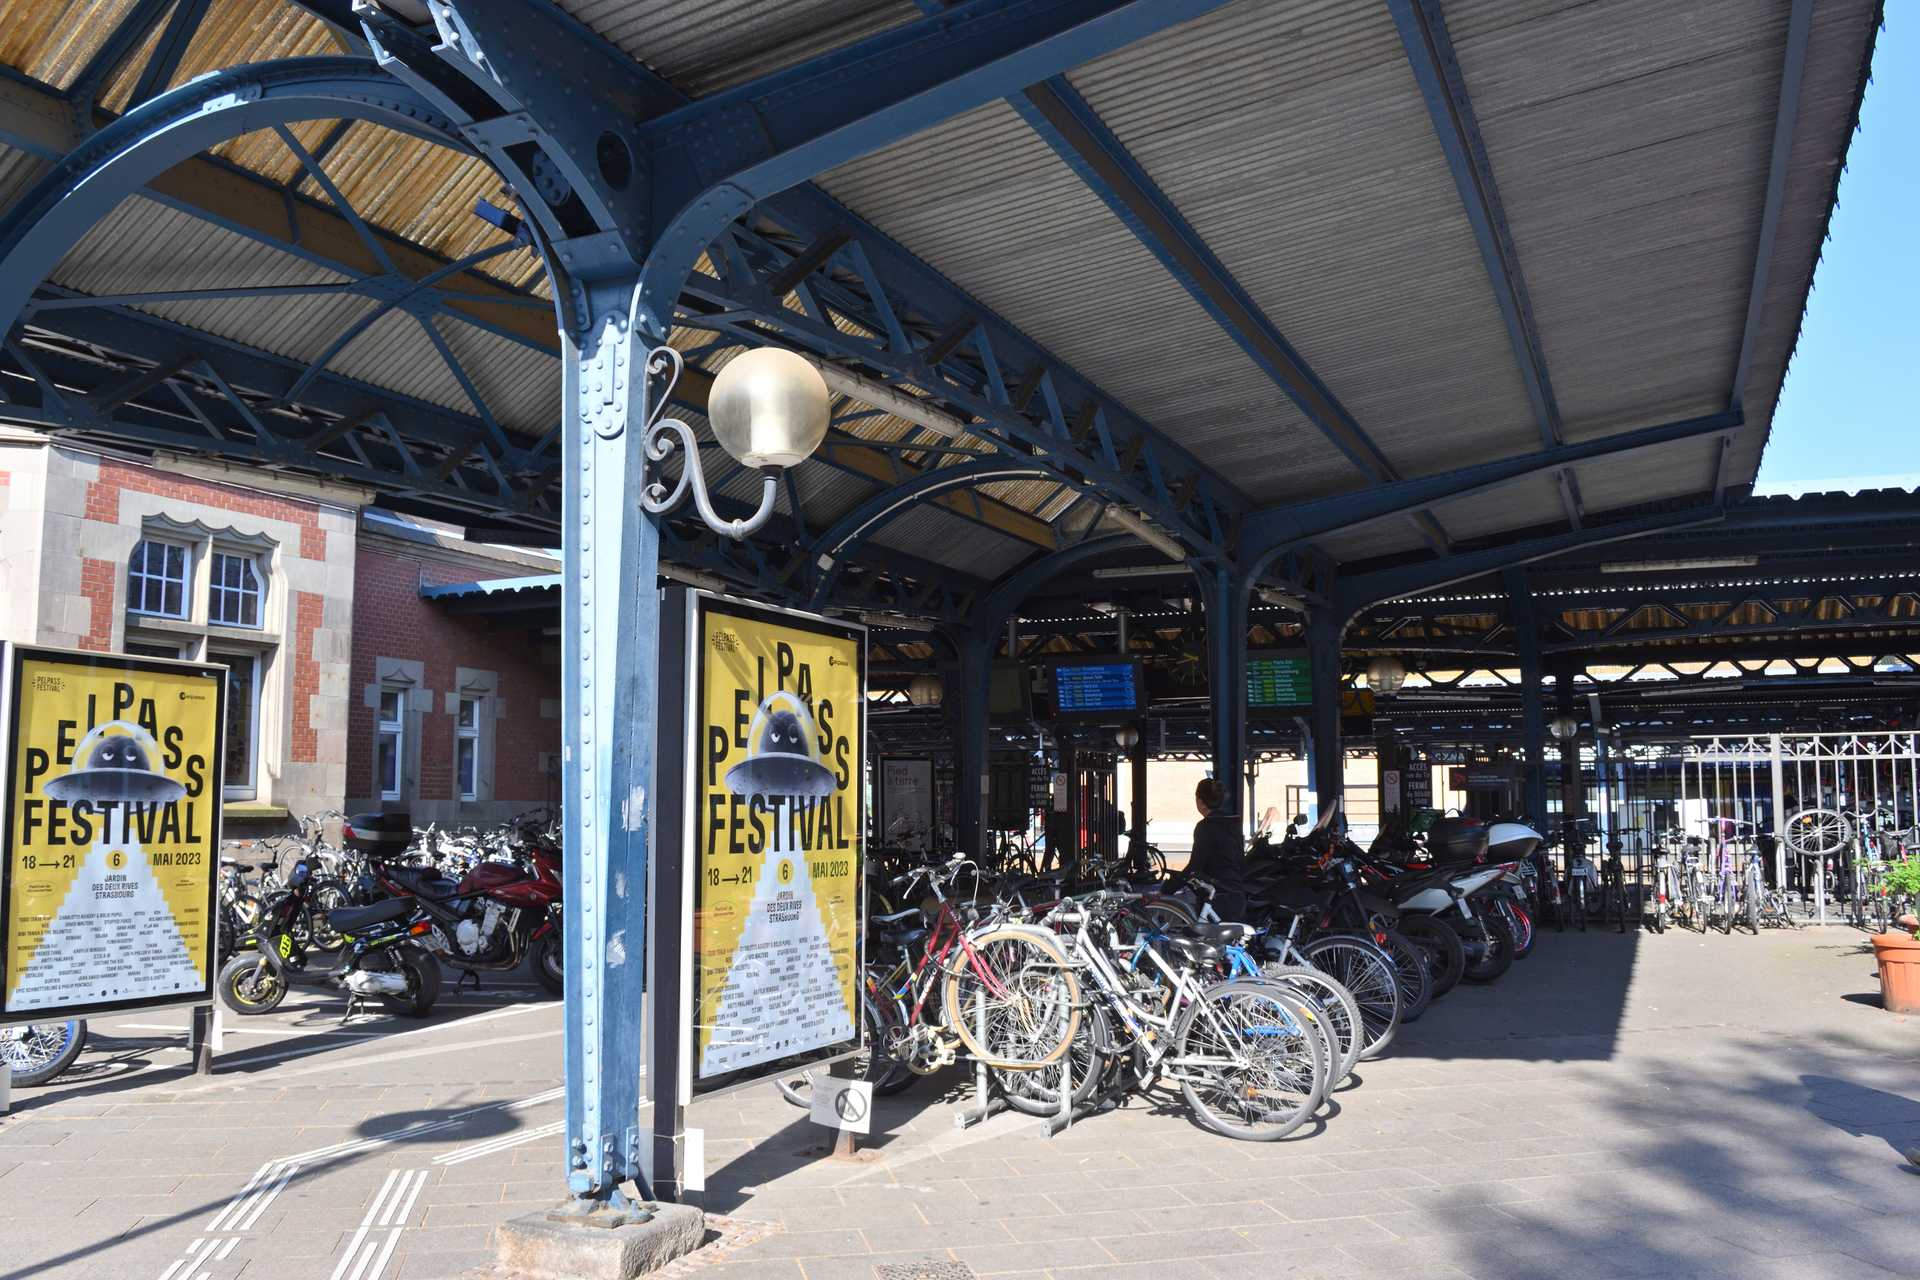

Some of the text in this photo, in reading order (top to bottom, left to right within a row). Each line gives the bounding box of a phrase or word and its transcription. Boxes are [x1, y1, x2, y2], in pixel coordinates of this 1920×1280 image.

[23, 800, 201, 845] FESTIVAL
[707, 793, 849, 855] FESTIVAL
[22, 854, 75, 869] 18 21
[112, 853, 121, 866] 6
[153, 851, 201, 866] MAI 2023
[708, 865, 753, 886] 18 21
[782, 863, 788, 880] 6
[813, 860, 849, 879] MAI 2023
[104, 874, 127, 882] JARDIN
[92, 882, 138, 891] DES DEUX RIVES
[95, 890, 135, 899] STRASBOURG
[776, 890, 794, 901] JARDIN
[766, 902, 776, 913] DES
[776, 901, 789, 912] DEUX
